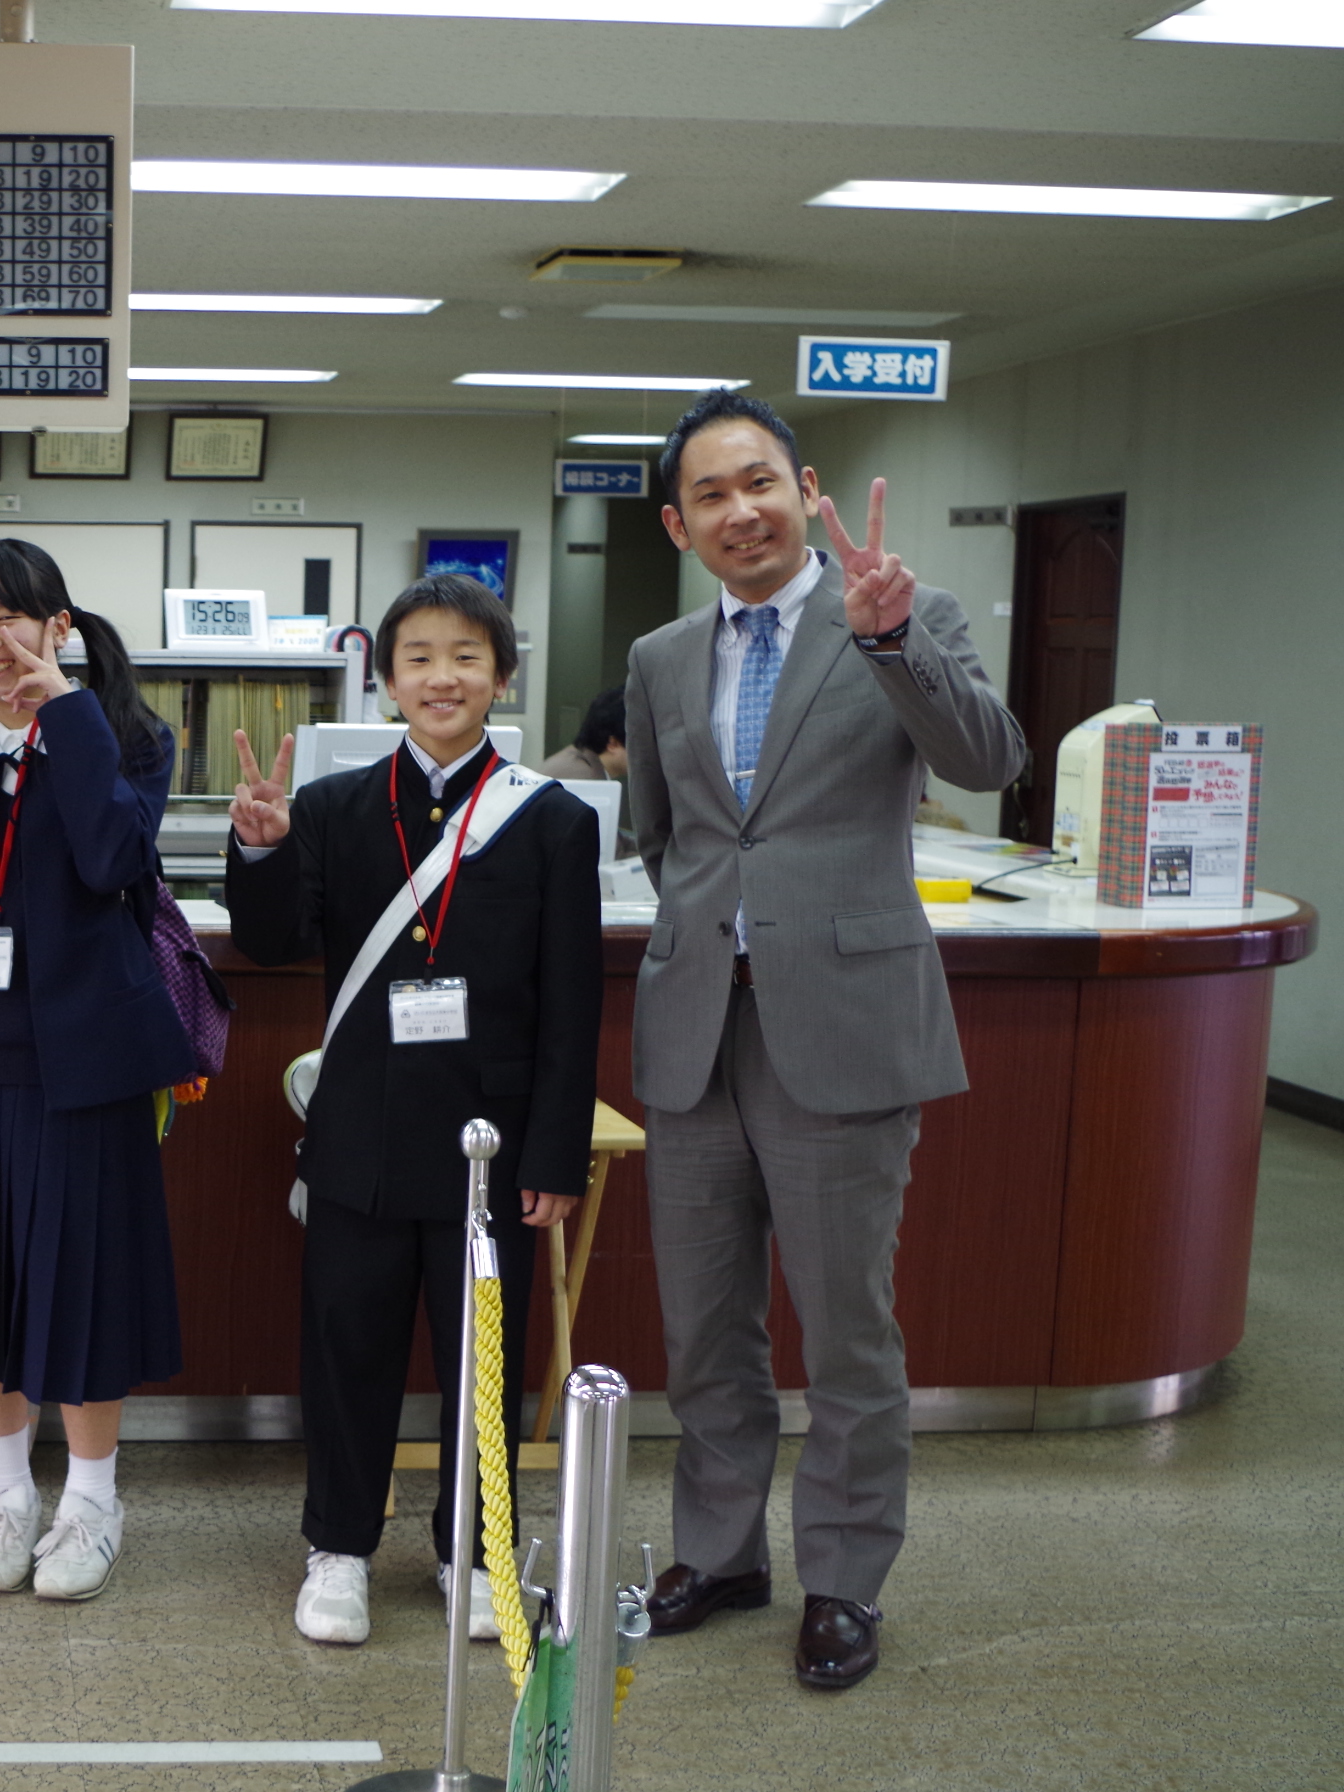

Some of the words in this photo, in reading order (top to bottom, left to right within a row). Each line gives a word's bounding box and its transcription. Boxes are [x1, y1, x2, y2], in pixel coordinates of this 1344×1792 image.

[31, 145, 46, 163] 9
[68, 145, 100, 164] 10
[23, 169, 52, 187] 19
[69, 169, 98, 188] 20
[22, 193, 52, 211] 29
[68, 193, 98, 212] 30
[22, 217, 52, 236] 39
[68, 217, 98, 236] 40
[22, 241, 52, 259] 49
[68, 241, 98, 260] 50
[22, 265, 52, 283] 59
[68, 265, 98, 284] 60
[68, 289, 98, 308] 70
[27, 346, 42, 365] 9
[67, 347, 97, 366] 10
[811, 351, 935, 386] 入学受付
[20, 370, 50, 389] 19
[67, 370, 97, 389] 20
[564, 471, 640, 487] 相談コーナー
[191, 601, 236, 623] 15:26
[1164, 731, 1240, 747] 投票箱
